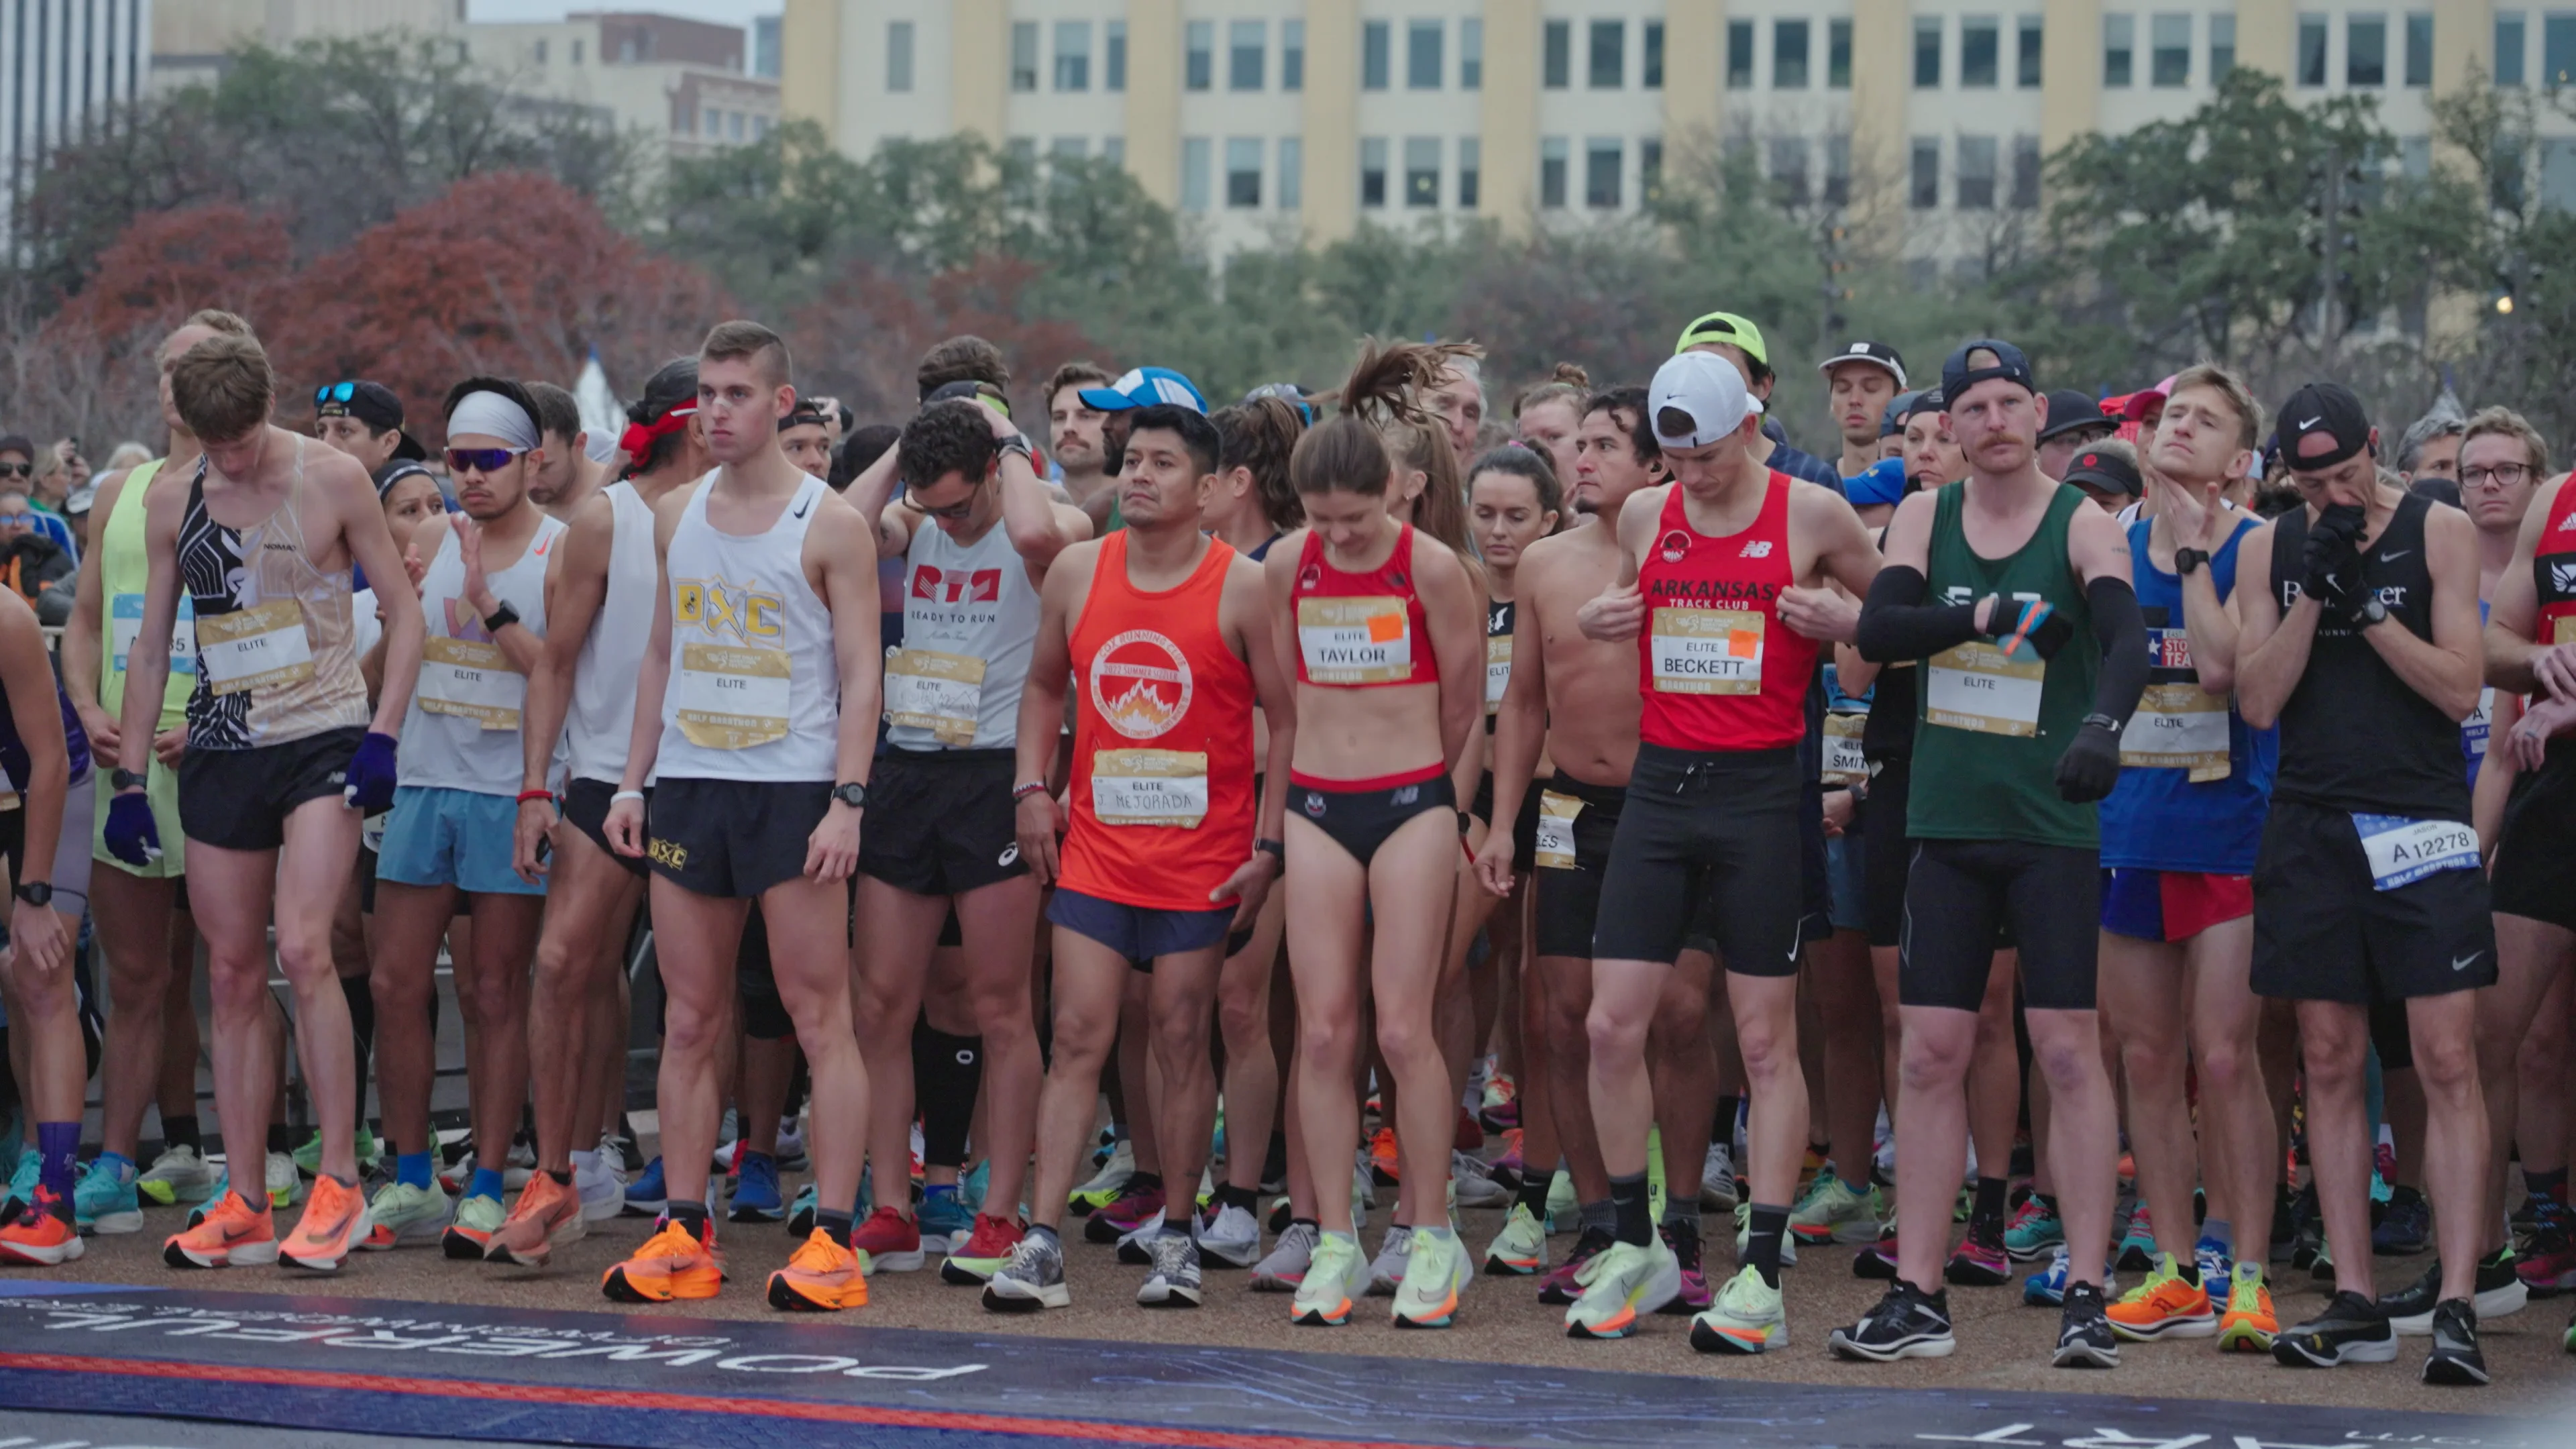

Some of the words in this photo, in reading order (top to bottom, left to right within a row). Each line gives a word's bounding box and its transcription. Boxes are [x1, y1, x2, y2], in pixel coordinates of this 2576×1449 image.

[1651, 578, 1775, 600] ARKANSAS
[1669, 598, 1711, 609] TRACK
[1716, 600, 1750, 611] CLUB
[911, 610, 944, 623] READY
[950, 613, 965, 623] TO
[971, 613, 996, 623] RUN
[1119, 630, 1167, 647] RUNNING
[1334, 631, 1366, 642] ELITE
[237, 637, 268, 652] ELITE
[1686, 642, 1719, 653] ELITE
[1318, 647, 1386, 664] TAYLOR
[1104, 665, 1122, 675] 2022
[1123, 665, 1152, 678] SUMMER
[1489, 666, 1509, 676] ELIT
[1664, 657, 1744, 676] BECKETT
[454, 669, 482, 682] ELITE
[716, 677, 747, 690] ELITE
[916, 680, 942, 692] ELITE
[1964, 676, 1996, 690] ELITE
[2154, 717, 2184, 728] ELITE
[1833, 754, 1866, 769] SMIT
[1132, 781, 1164, 792] ELITE
[1116, 794, 1193, 810] MEJORADA
[44, 1311, 990, 1381] POWERFUL
